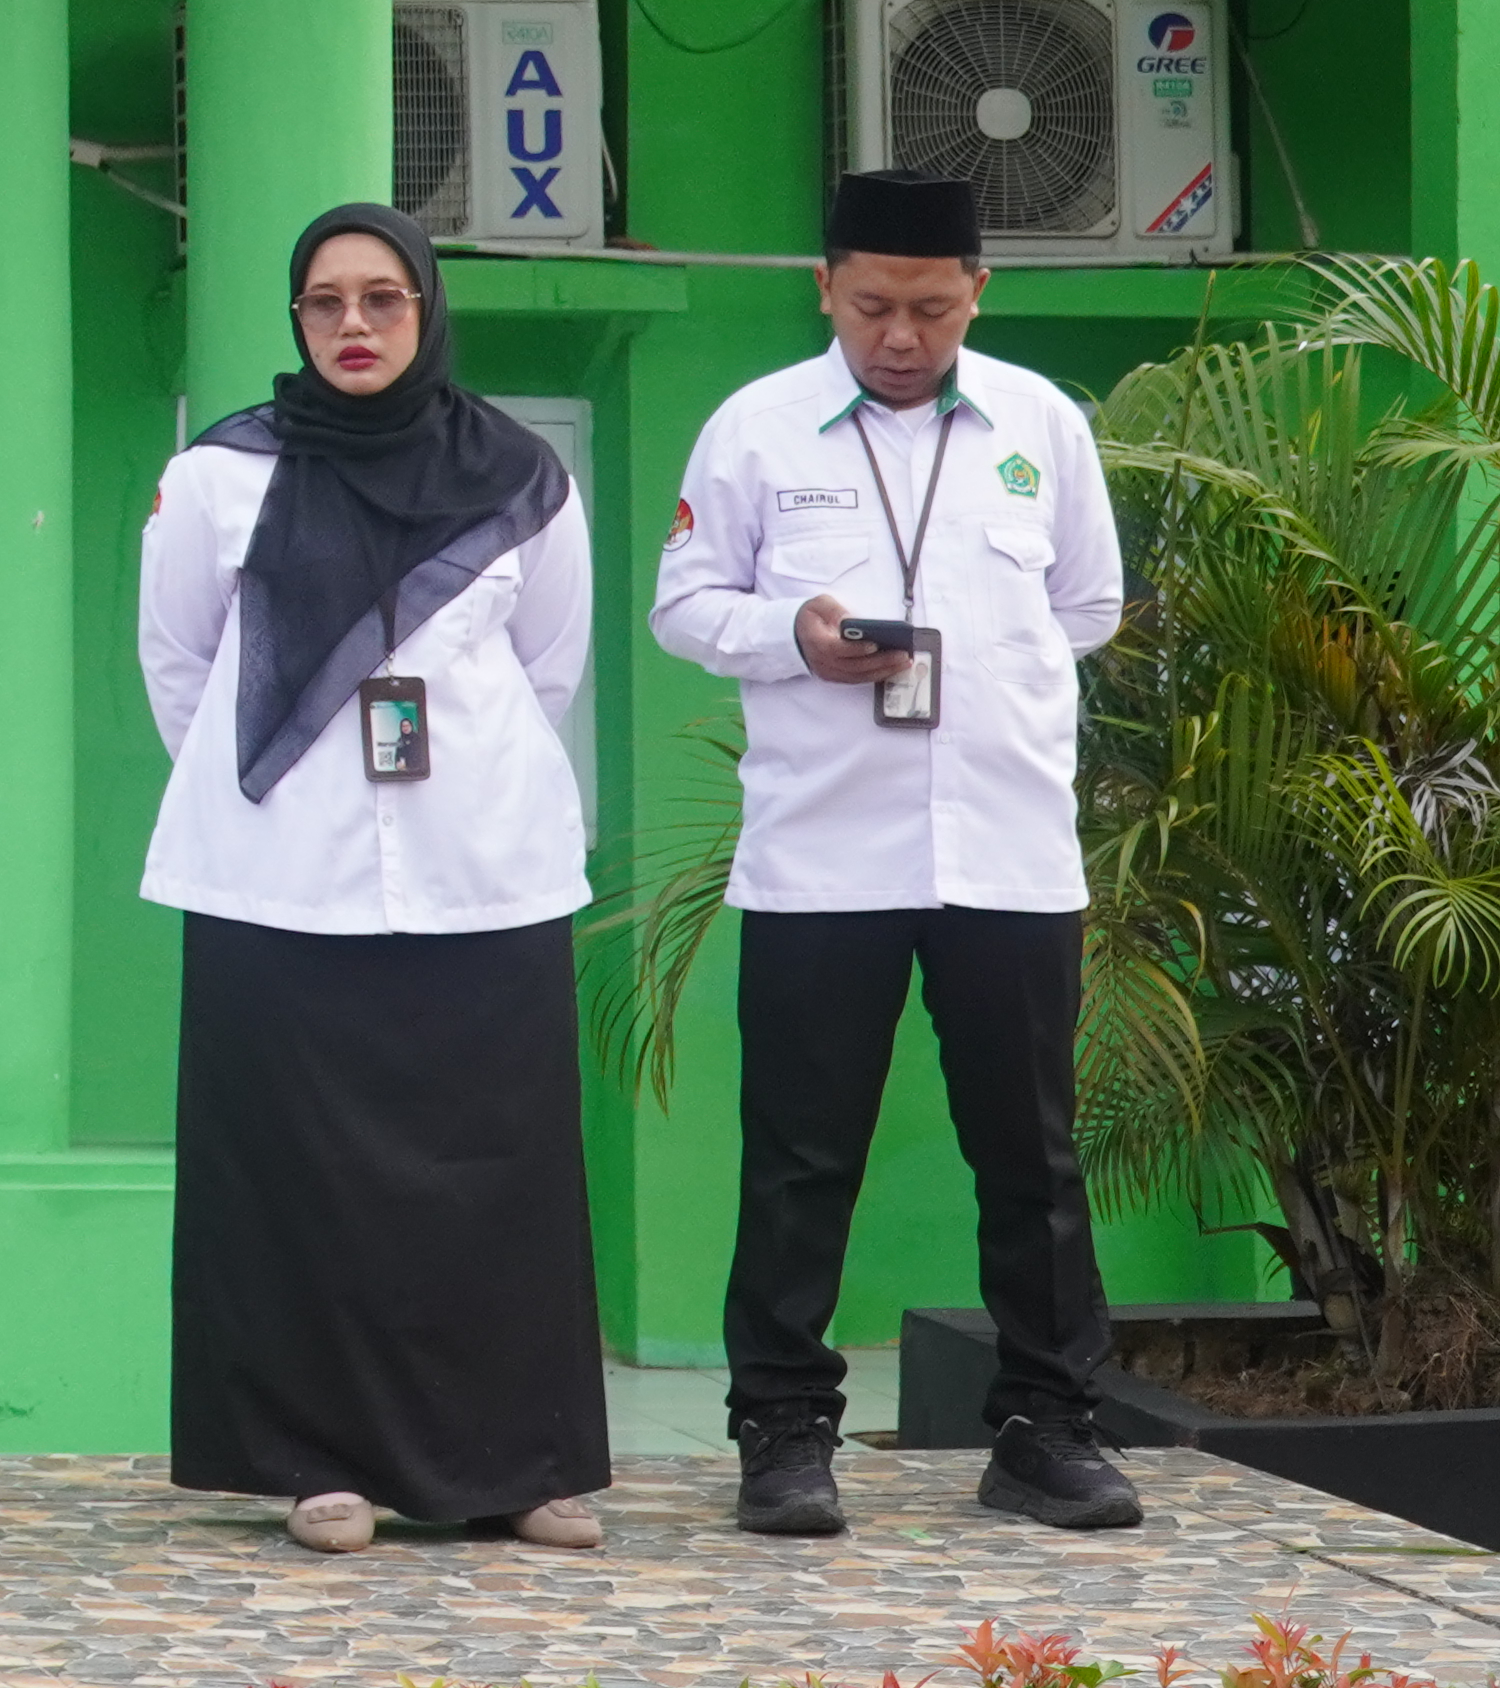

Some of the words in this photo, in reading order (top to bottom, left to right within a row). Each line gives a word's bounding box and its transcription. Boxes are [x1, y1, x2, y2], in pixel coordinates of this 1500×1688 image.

[1137, 56, 1207, 75] GREE
[504, 50, 564, 219] AUX
[793, 494, 841, 505] CHAIRUL
